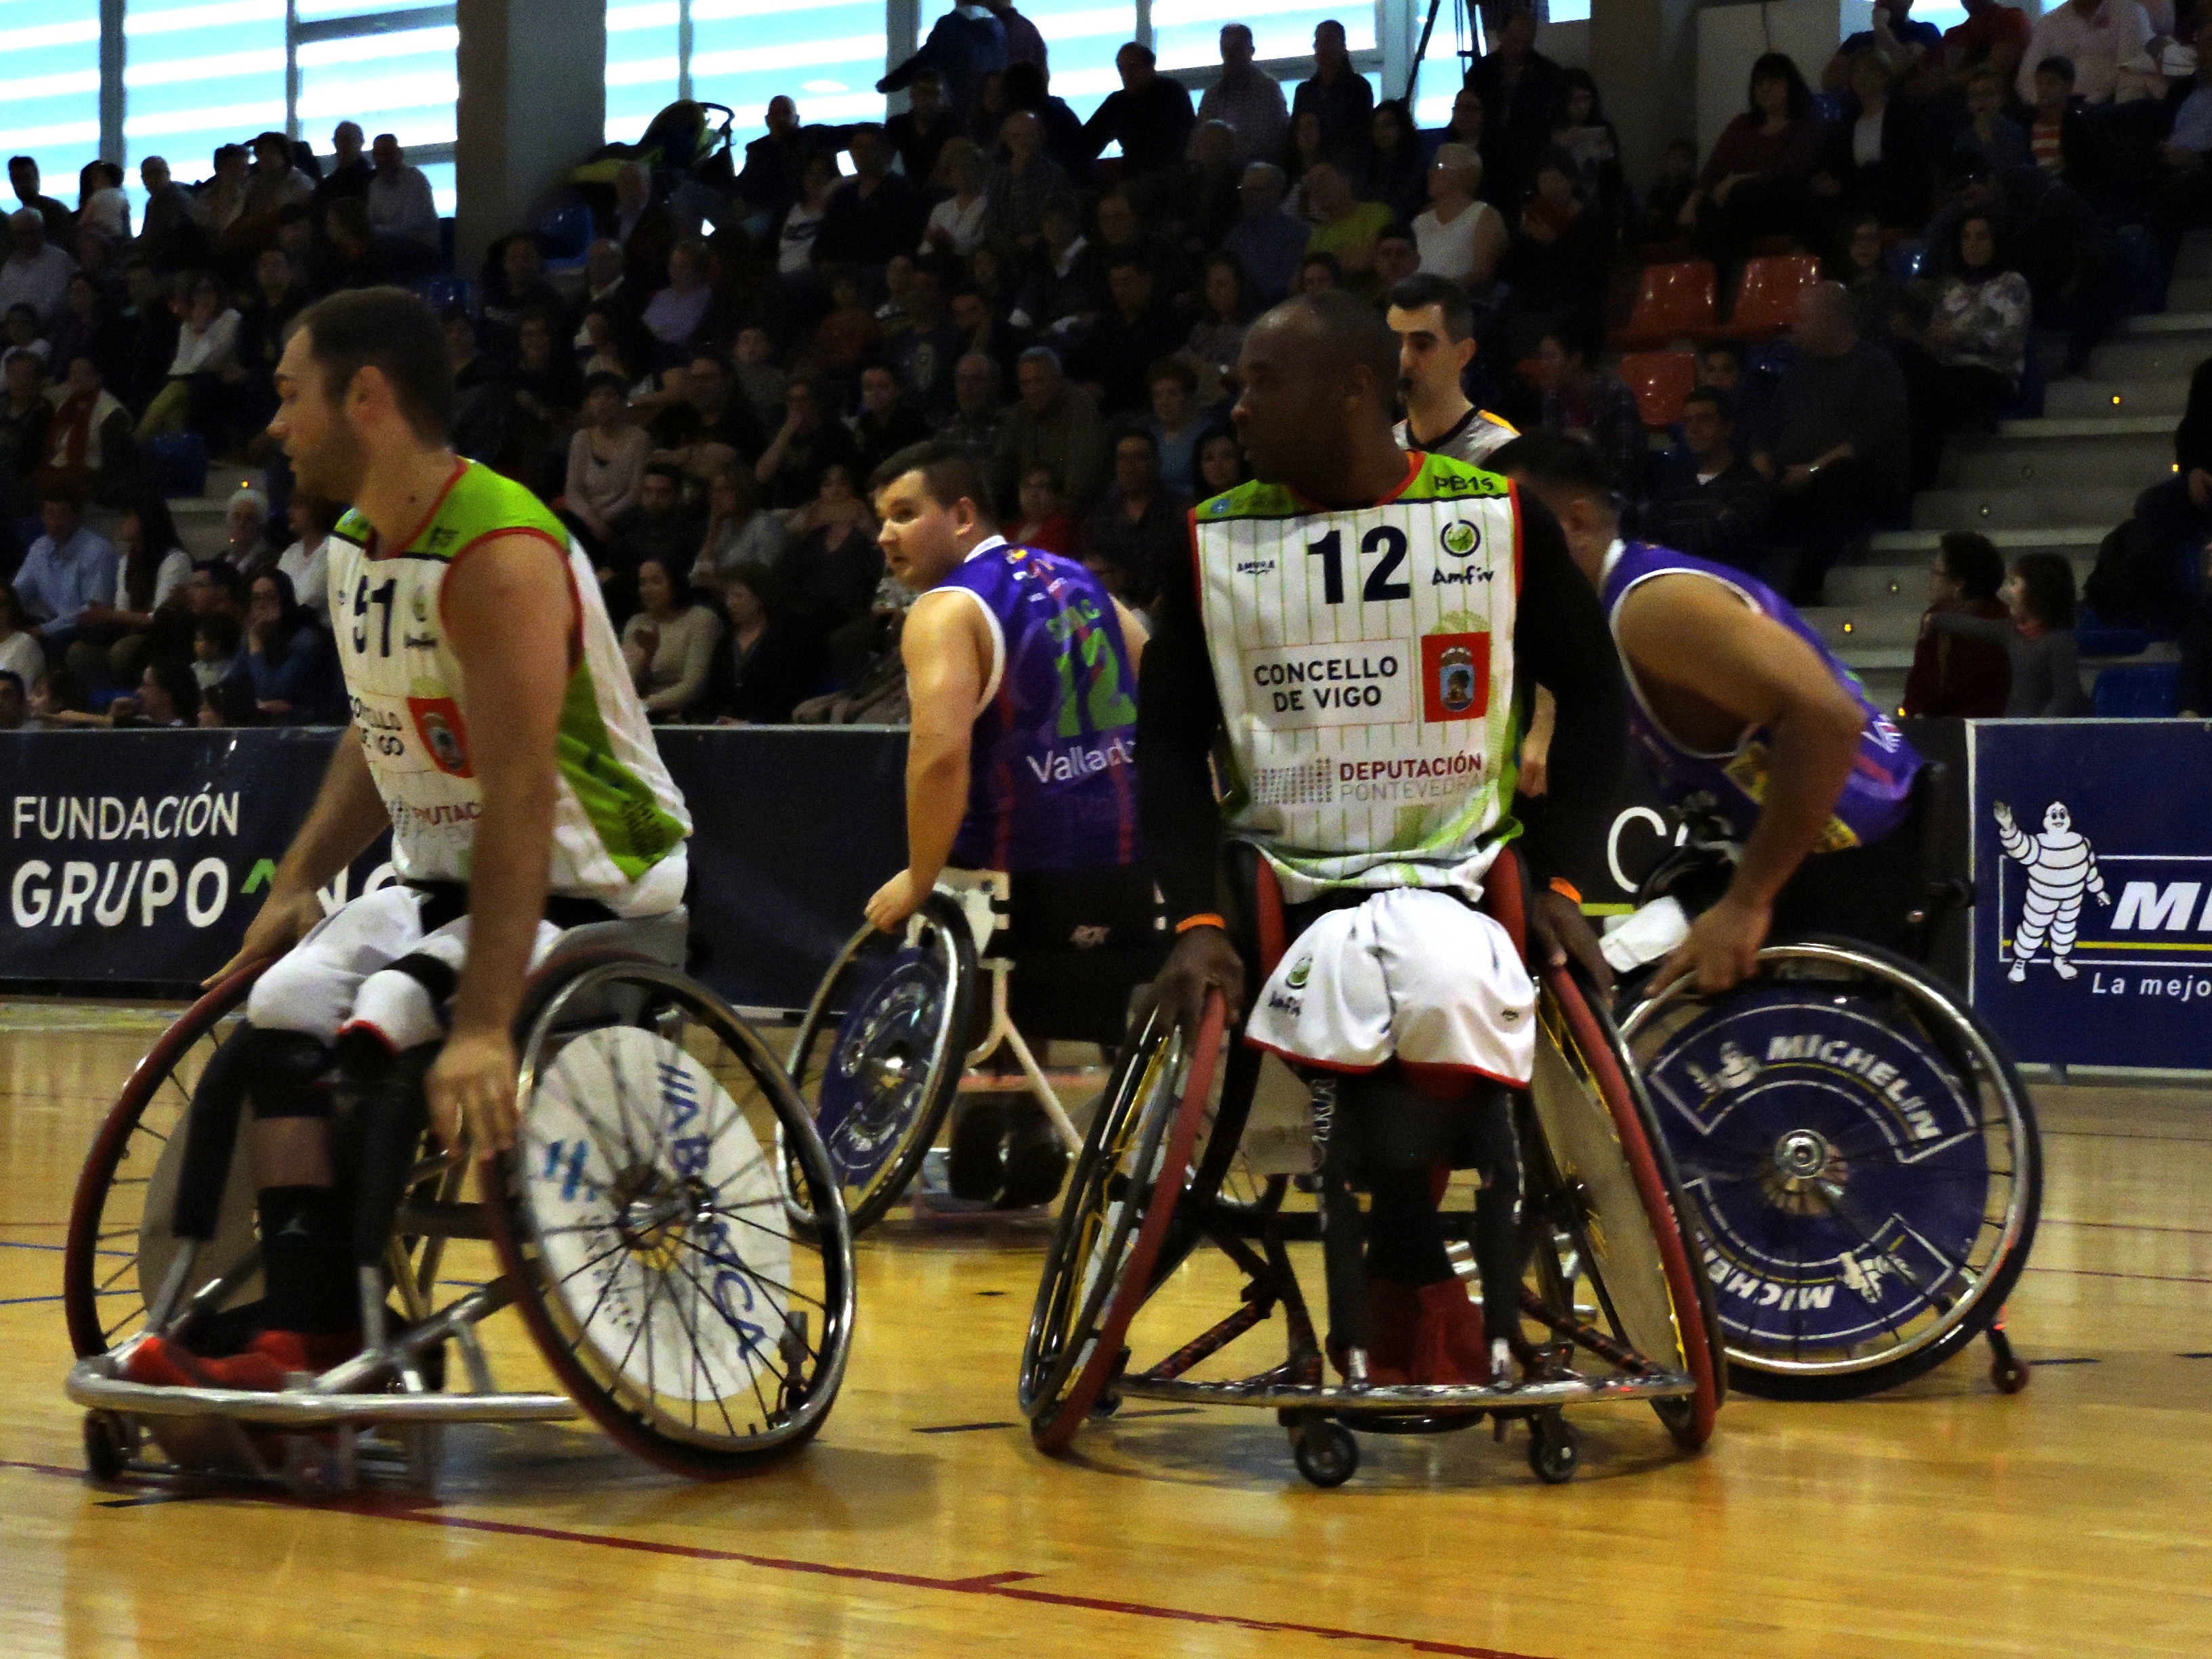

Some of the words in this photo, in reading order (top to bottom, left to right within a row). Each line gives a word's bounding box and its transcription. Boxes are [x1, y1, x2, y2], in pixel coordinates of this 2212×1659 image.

[1307, 525, 1410, 605] 12
[1432, 565, 1495, 586] Amfiv
[353, 575, 398, 658] 51
[1054, 627, 1139, 739] 12
[1254, 655, 1399, 687] CONCELLO
[1273, 689, 1305, 713] DE
[1313, 685, 1382, 710] VIGO
[1339, 750, 1483, 781] DEPUTACIÓN
[13, 781, 241, 840] FUNDACIÓN
[10, 857, 229, 928] GRUPO
[2092, 972, 2125, 994] La
[2139, 975, 2212, 1002] mejo
[1766, 1034, 1943, 1141] MICHELIN
